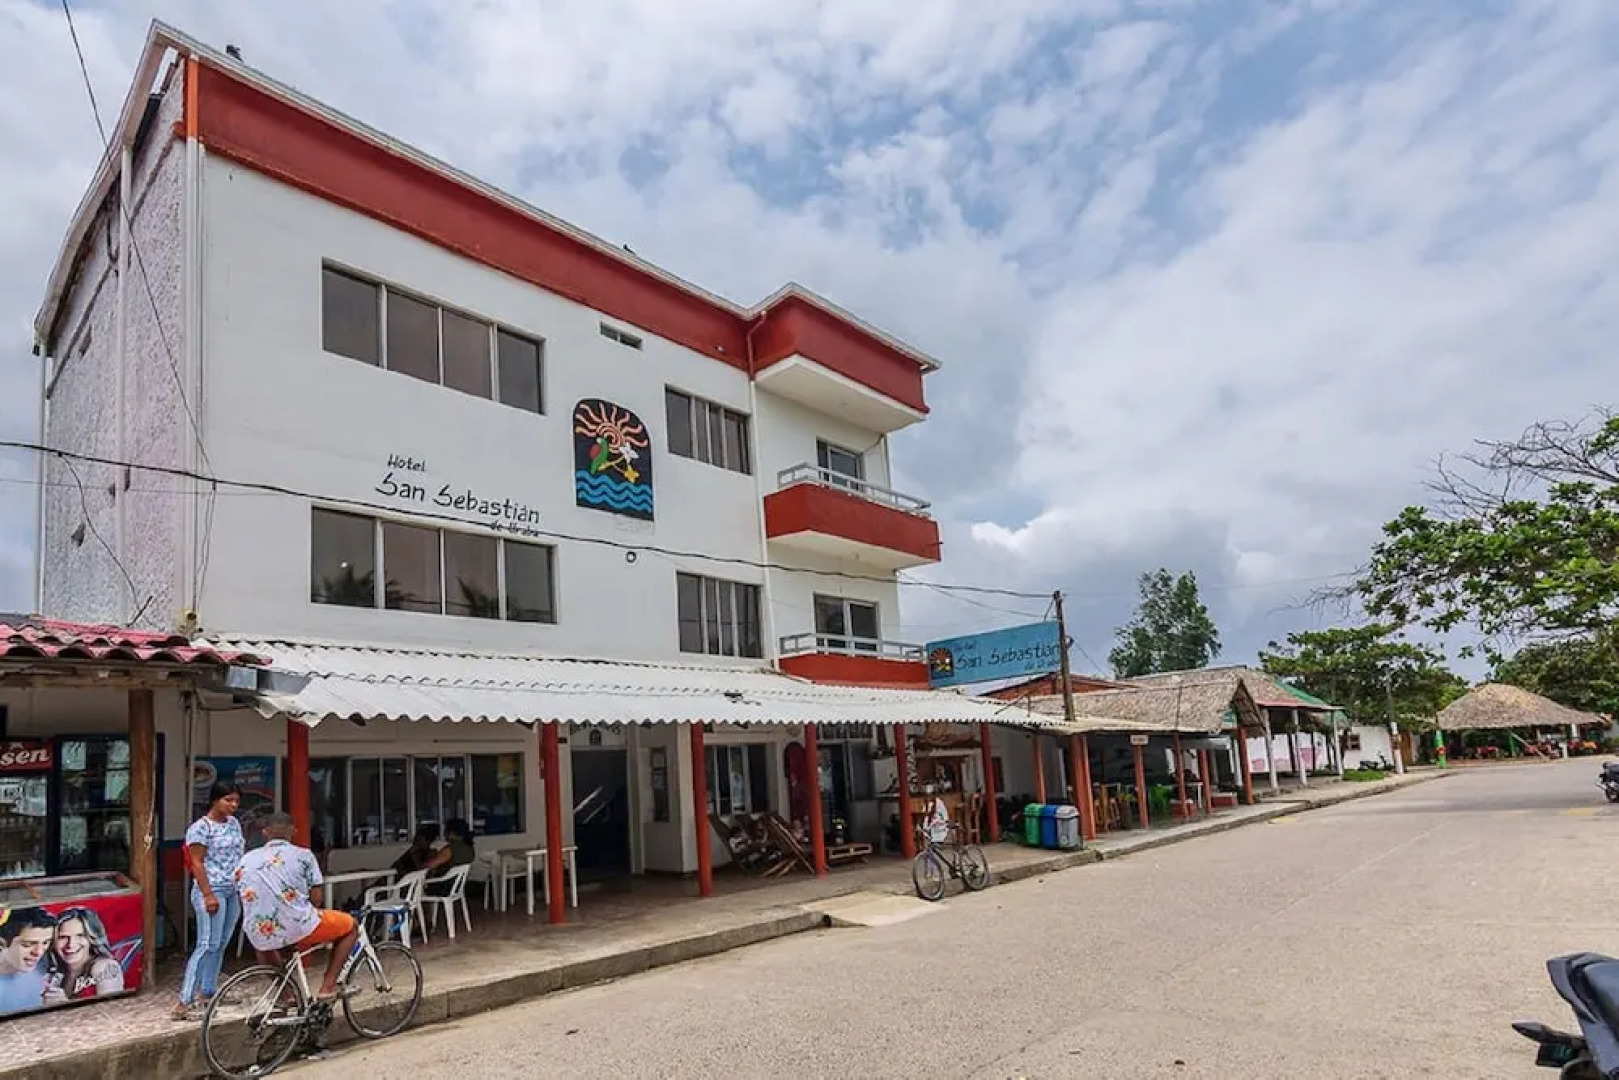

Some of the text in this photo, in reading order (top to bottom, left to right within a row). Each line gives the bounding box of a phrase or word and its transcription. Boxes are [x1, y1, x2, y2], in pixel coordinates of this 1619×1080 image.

[387, 453, 426, 472] Hotel
[375, 472, 425, 502] San
[955, 654, 982, 670] San
